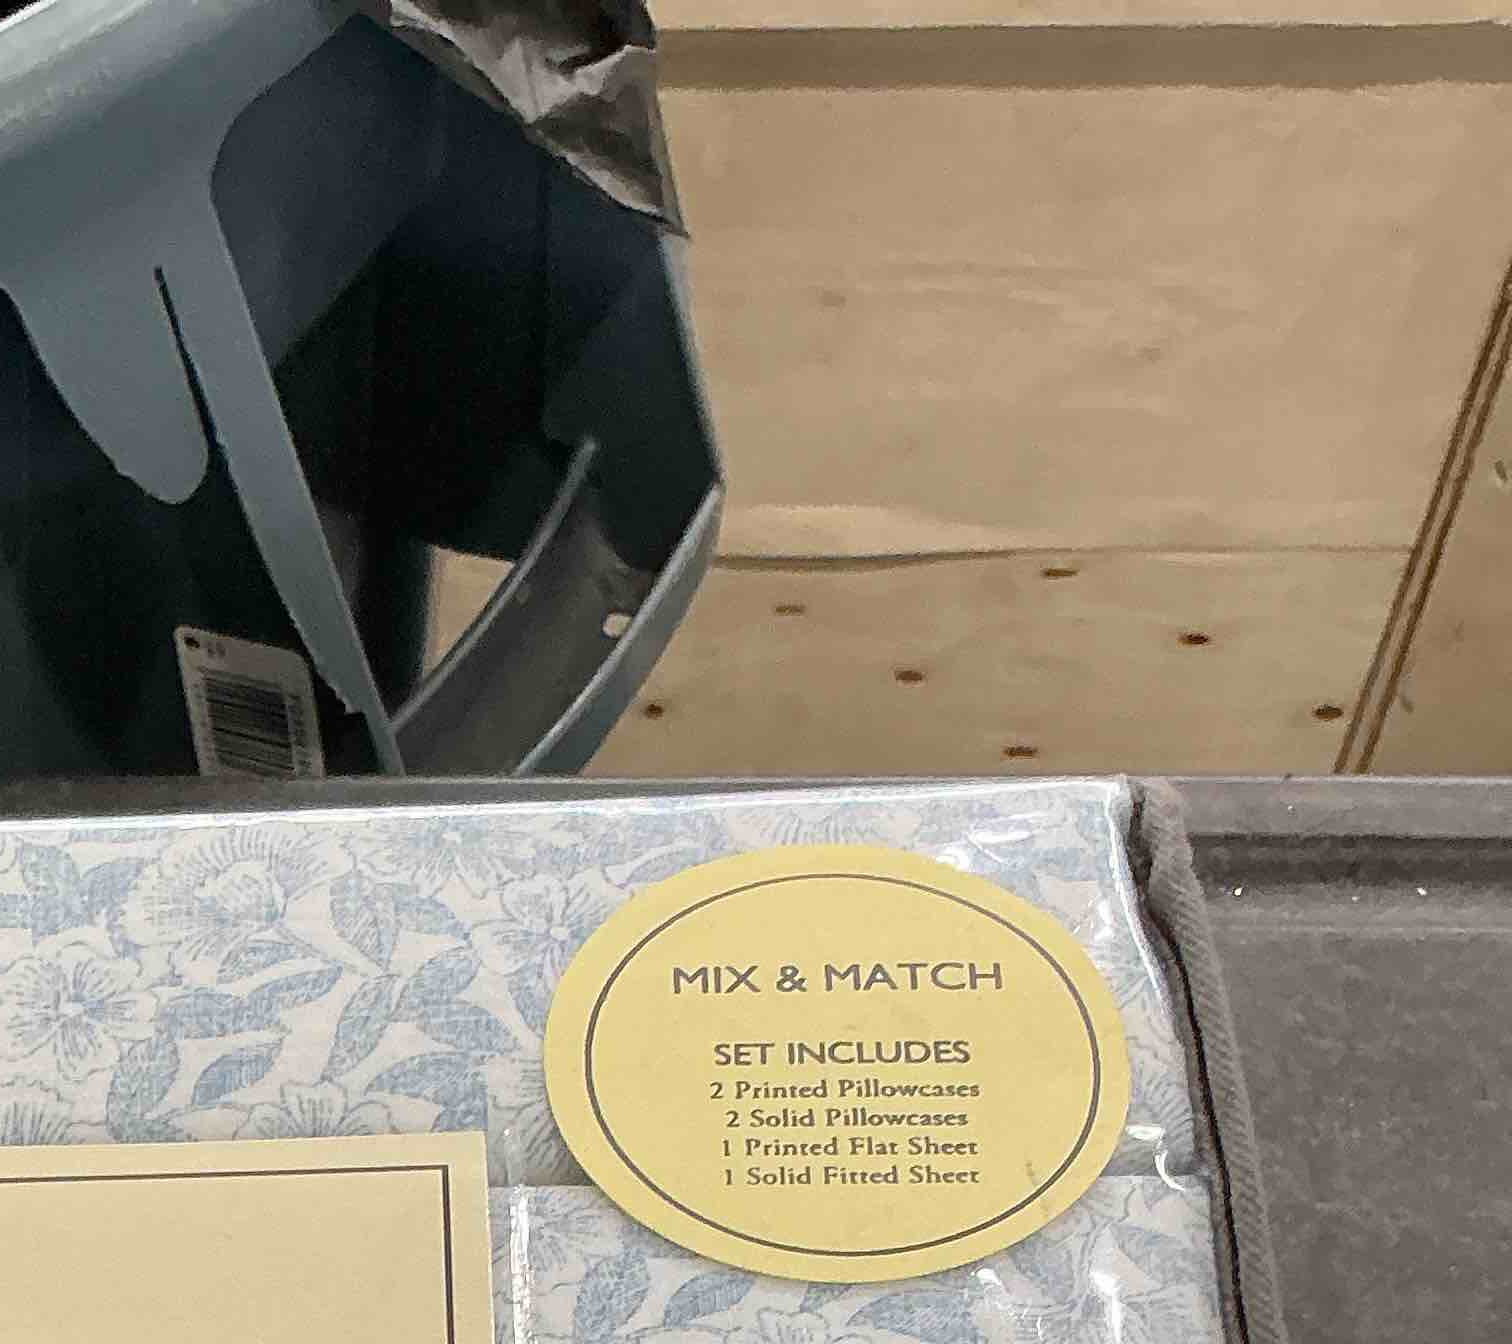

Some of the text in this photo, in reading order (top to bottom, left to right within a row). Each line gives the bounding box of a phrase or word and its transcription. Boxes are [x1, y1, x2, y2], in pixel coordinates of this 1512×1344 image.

[673, 963, 1003, 994] MIX & MATCH
[713, 1040, 971, 1066] SET INCLUDES
[709, 1078, 981, 1100] 2 Printed Pillowcases
[726, 1107, 969, 1128] 2 Solid Pillowcases
[721, 1136, 979, 1157] 1 Printed Flat Sheet
[724, 1165, 980, 1186] 1 Solid Fitted Sheet
